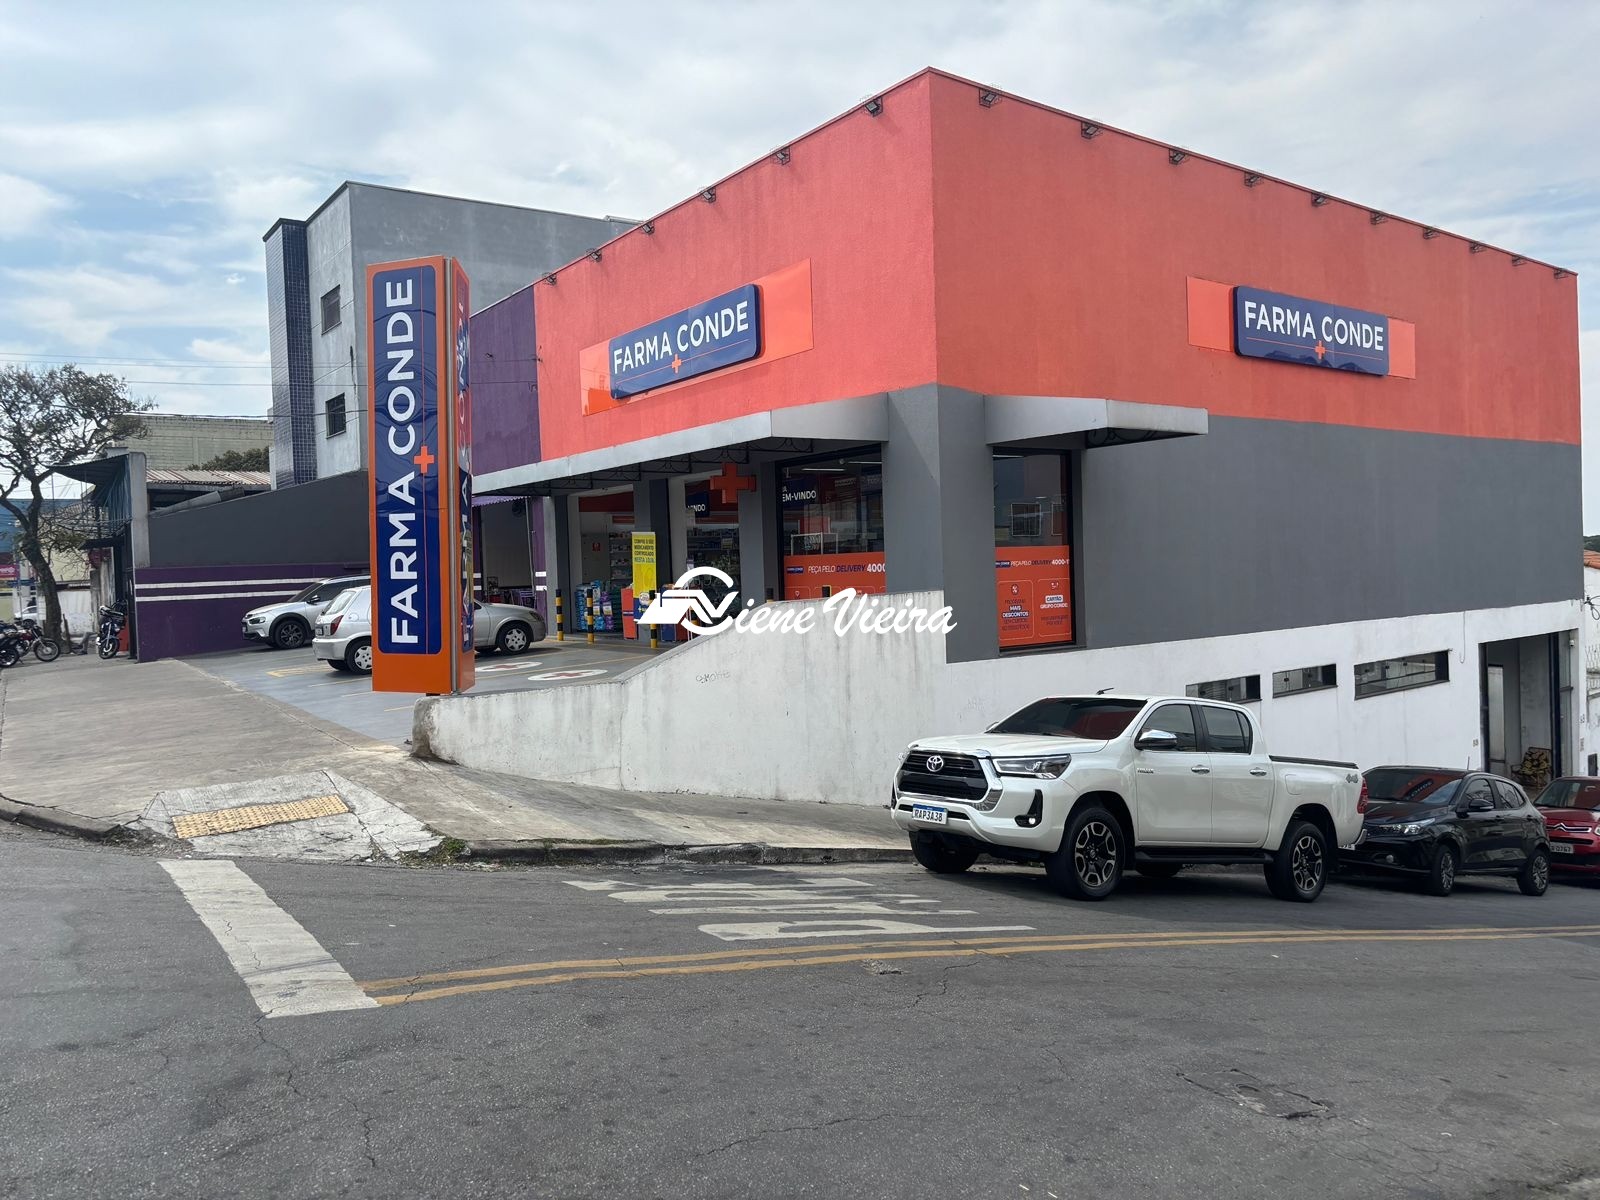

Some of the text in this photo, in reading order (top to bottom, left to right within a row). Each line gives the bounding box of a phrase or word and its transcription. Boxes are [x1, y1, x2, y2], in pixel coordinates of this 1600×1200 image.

[613, 300, 749, 375] FARMA CONDE
[1244, 300, 1384, 352] FARMA CONDE
[386, 278, 420, 646] FARMA CONDE
[822, 565, 836, 573] PELO
[836, 564, 866, 573] DELIVERY
